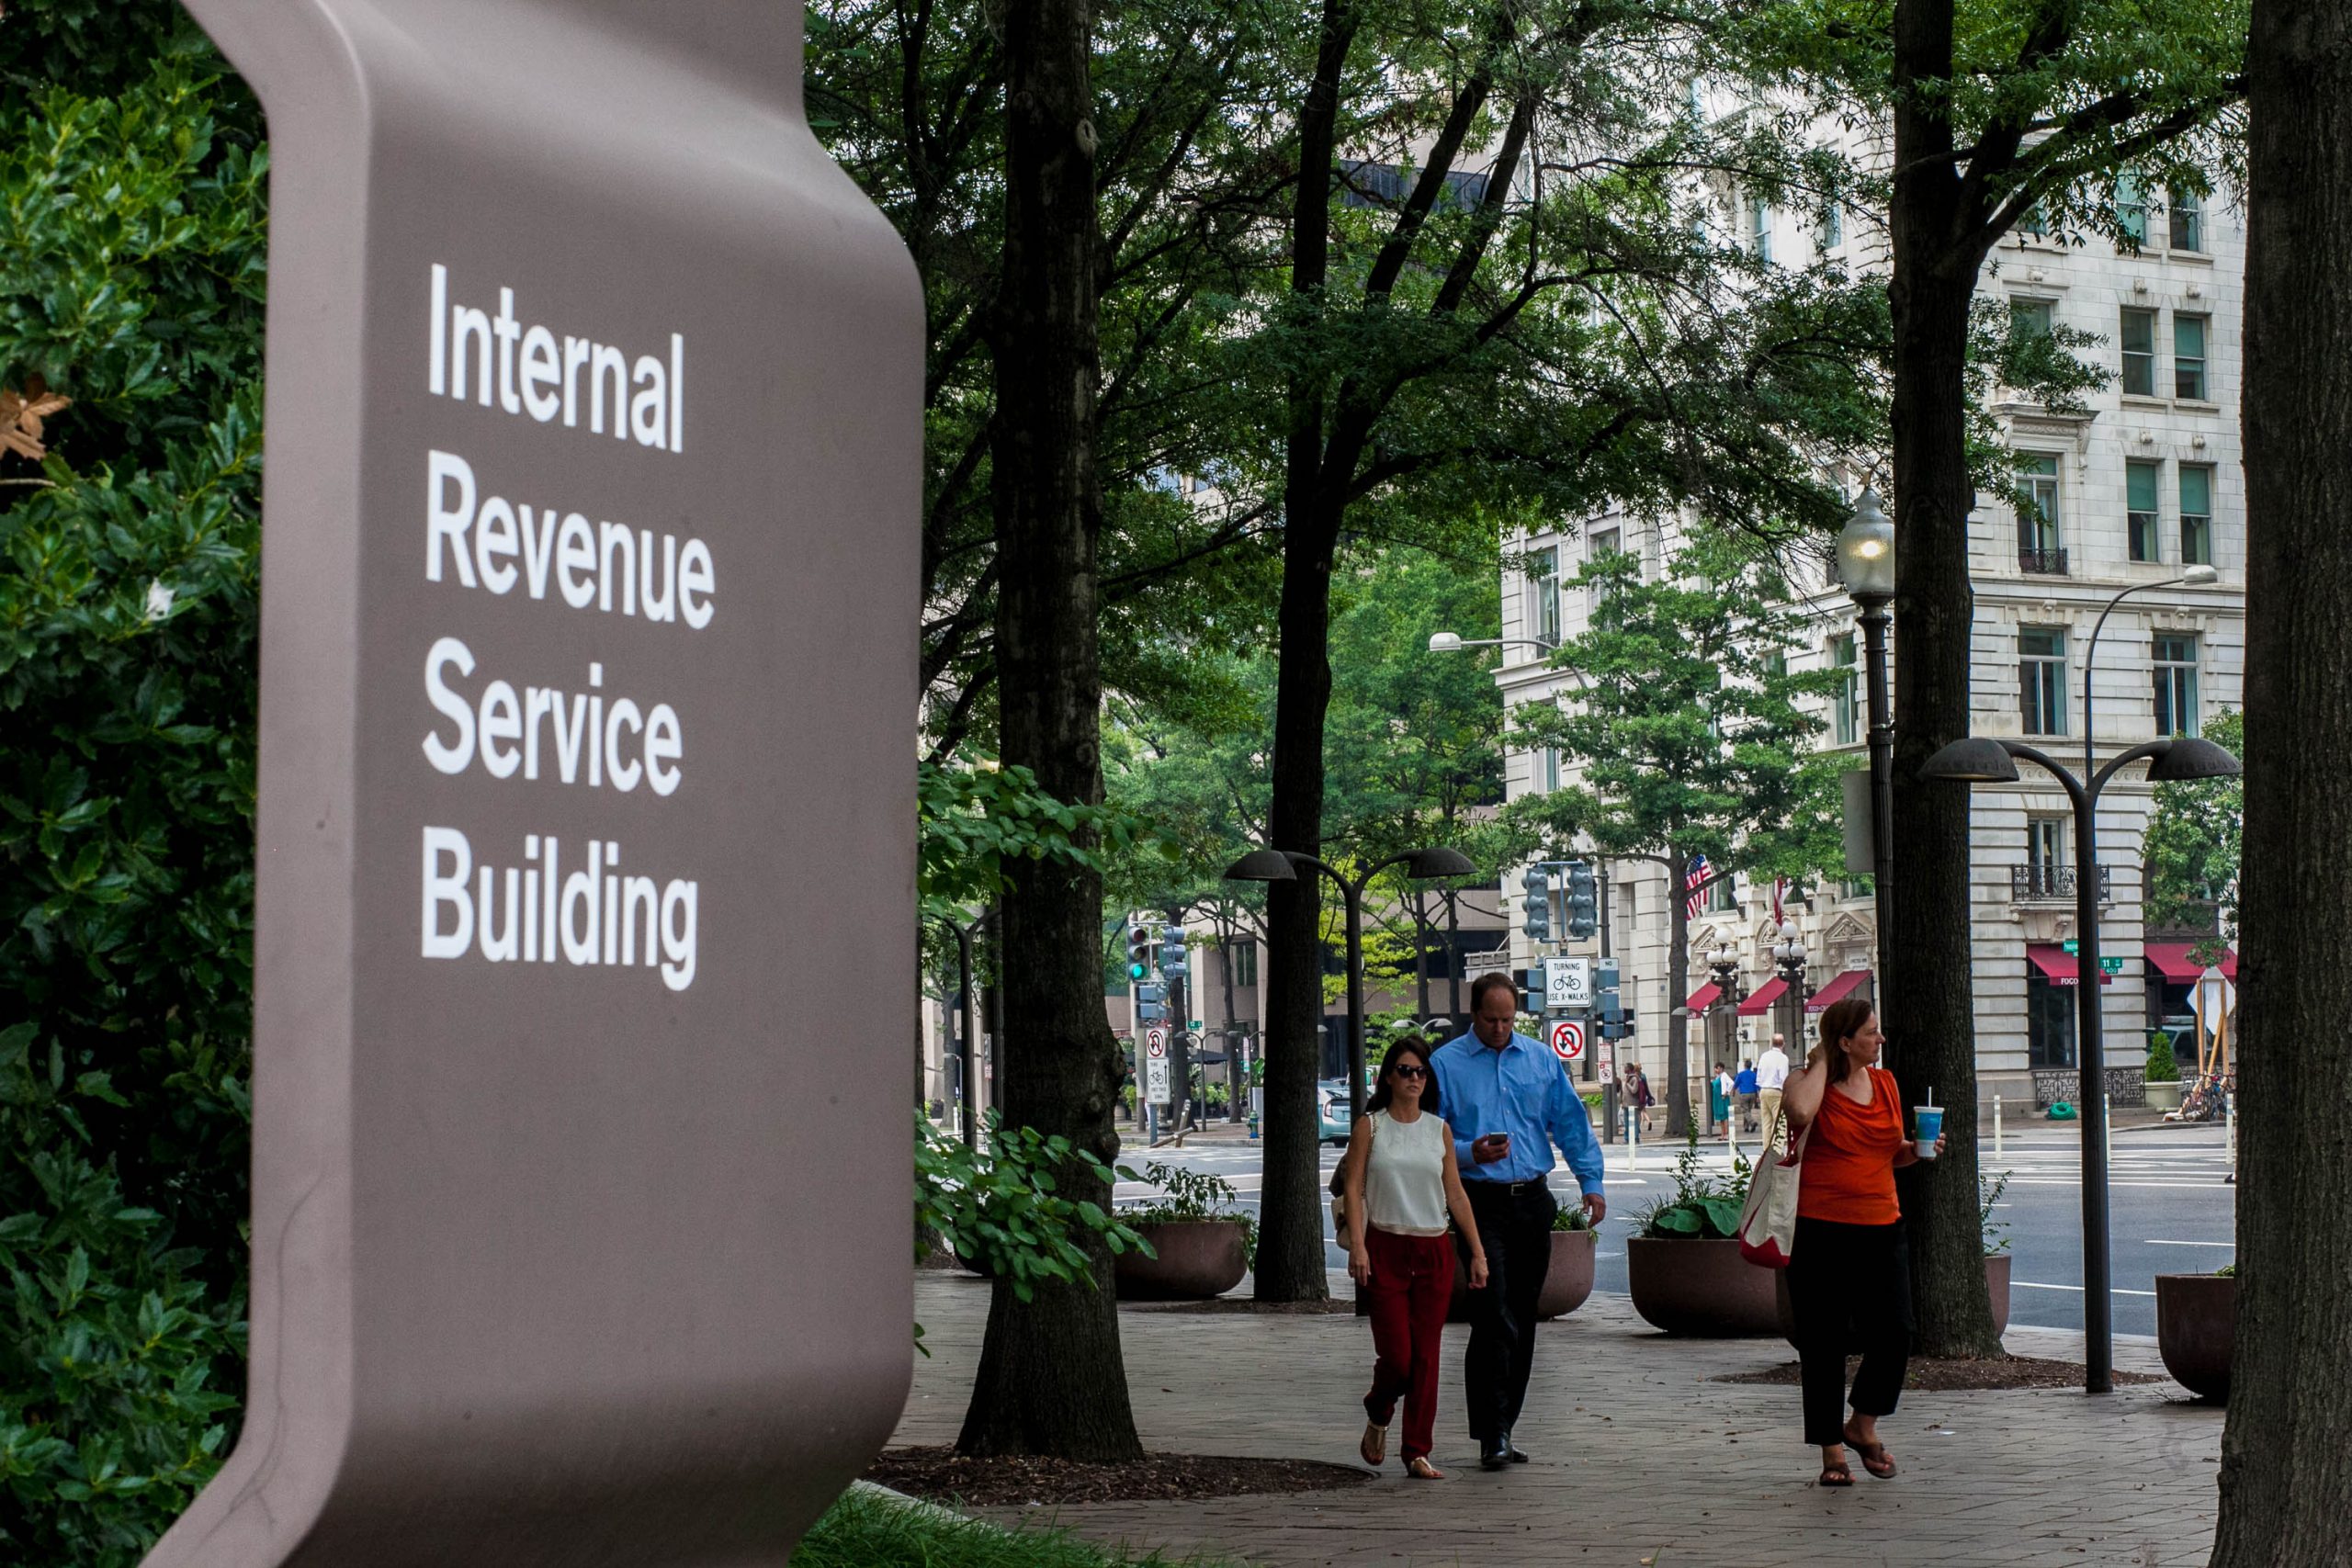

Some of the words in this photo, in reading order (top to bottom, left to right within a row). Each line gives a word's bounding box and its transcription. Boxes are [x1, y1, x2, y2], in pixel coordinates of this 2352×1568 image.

[429, 263, 684, 454] Internal
[425, 449, 716, 630] Revenue
[422, 637, 683, 796] Service
[421, 826, 698, 992] Building
[1554, 963, 1580, 971] TURNING
[2102, 959, 2109, 967] 11
[1548, 993, 1559, 1001] USE
[1562, 992, 1589, 1000] X-WALKS
